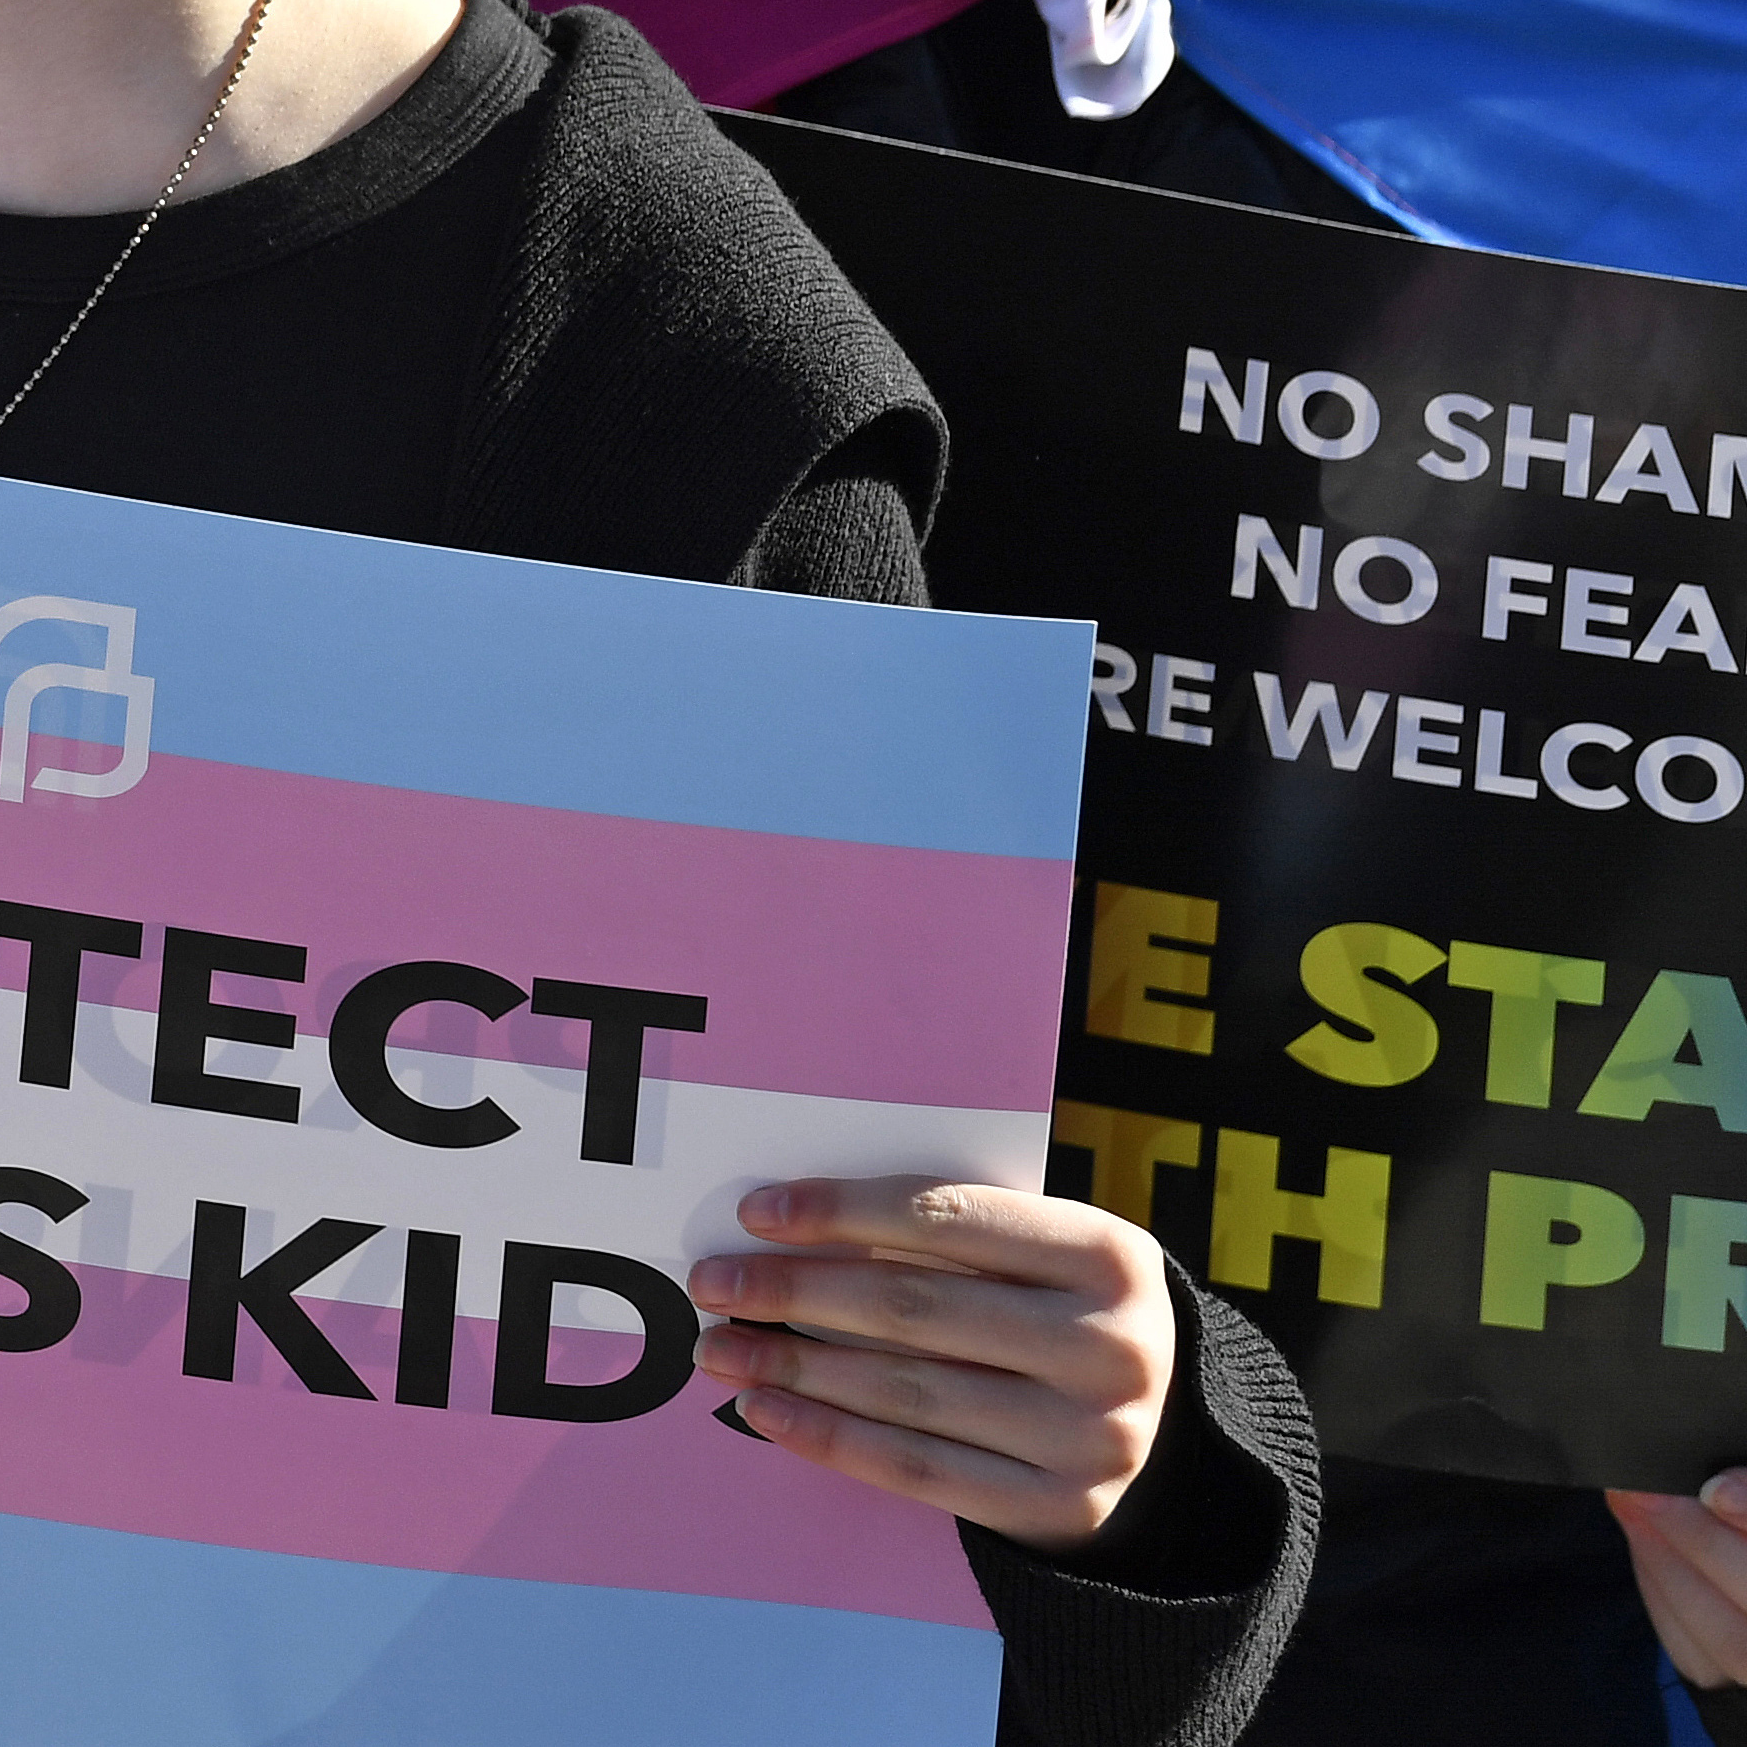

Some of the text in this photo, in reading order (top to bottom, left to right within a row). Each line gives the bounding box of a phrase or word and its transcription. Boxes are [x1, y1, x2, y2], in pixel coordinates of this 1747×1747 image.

[1178, 345, 1381, 461] NO
[1229, 513, 1747, 675] NO FEA
[1252, 670, 1746, 824] WELCO
[1074, 878, 1747, 1135] E STA
[180, 1198, 825, 1444] KID
